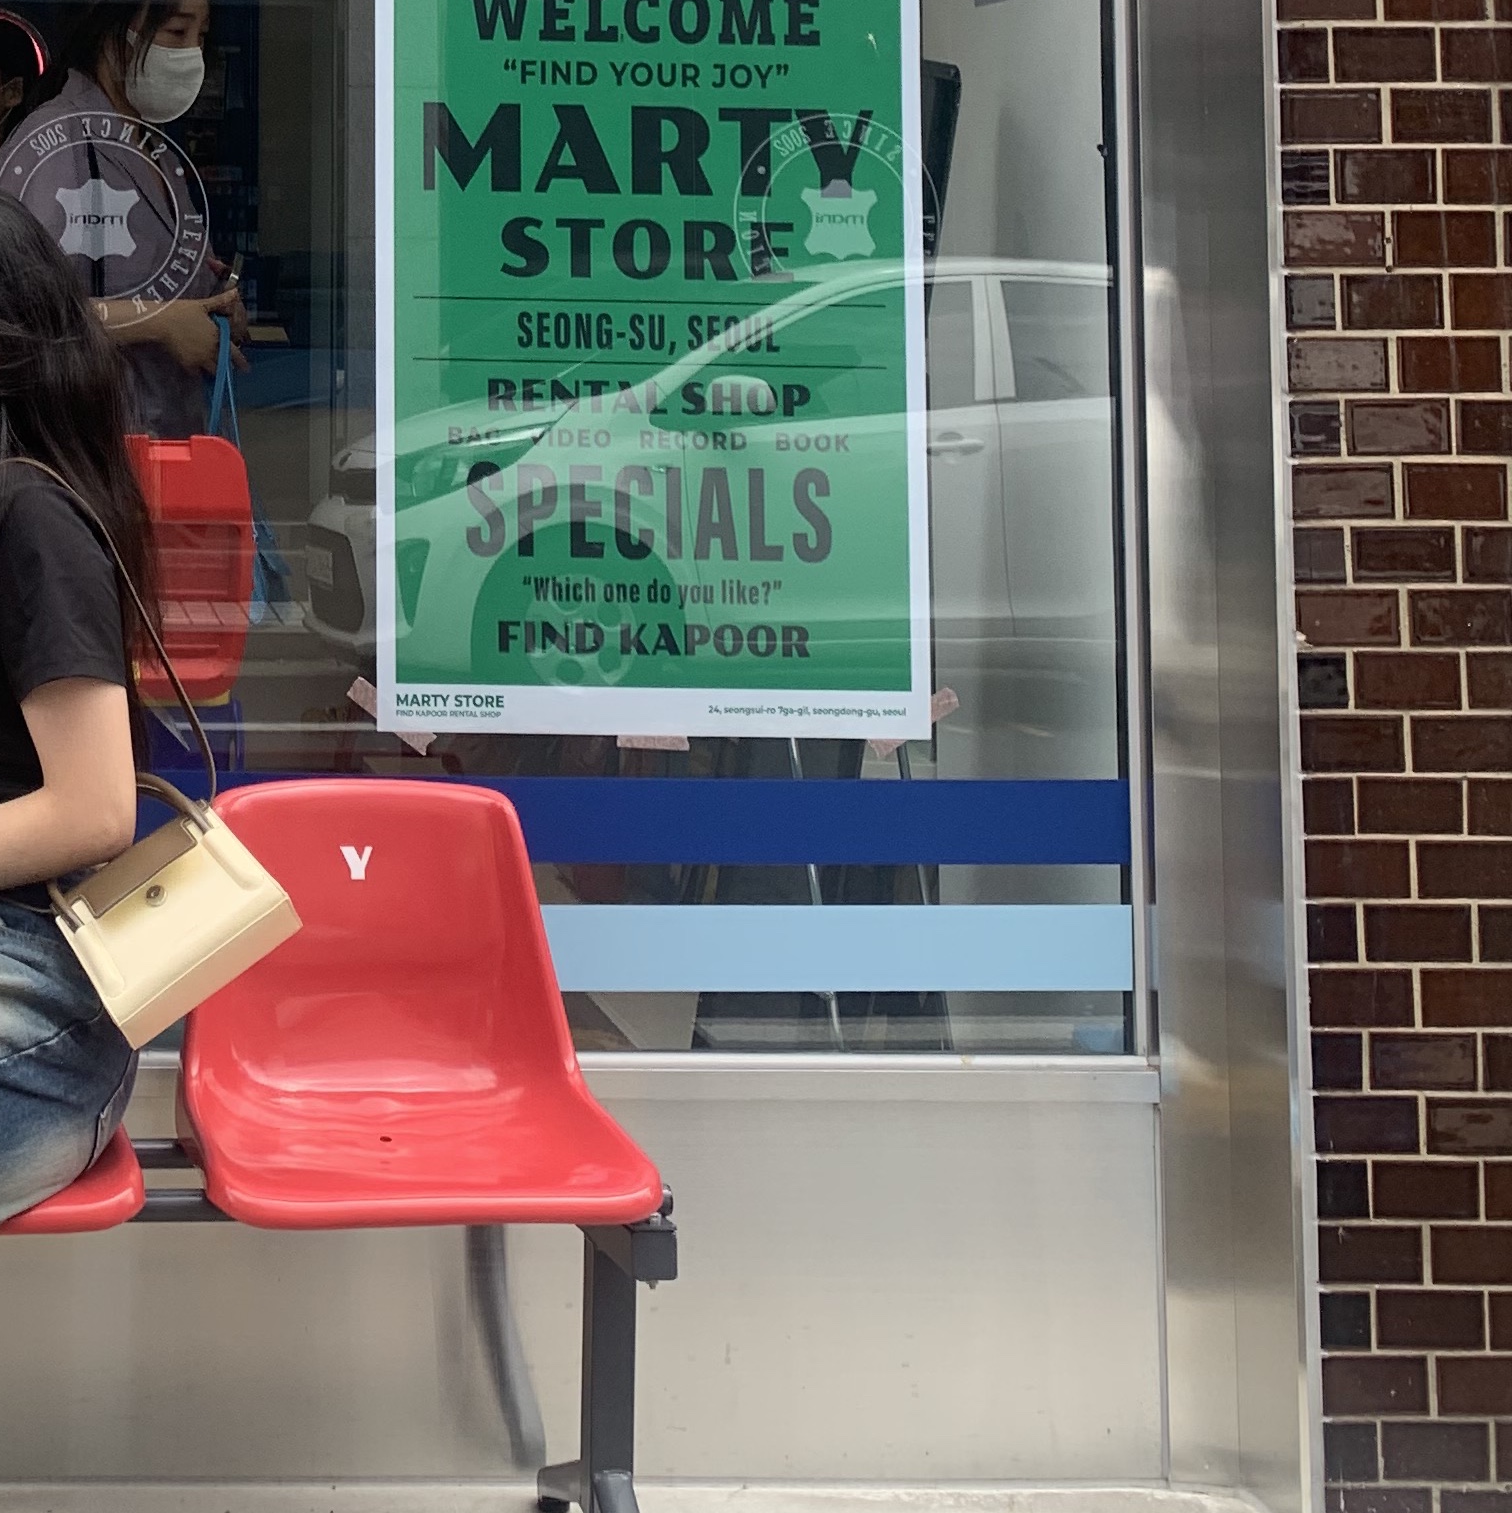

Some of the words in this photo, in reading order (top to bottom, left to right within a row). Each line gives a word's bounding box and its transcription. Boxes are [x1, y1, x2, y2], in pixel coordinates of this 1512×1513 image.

[608, 61, 701, 88] YOUR
[422, 101, 874, 199] MARTY
[499, 216, 794, 282] STORE
[516, 311, 677, 356] SEONG-SU,
[686, 314, 781, 354] SEOUL
[487, 377, 668, 415] RENTAL
[681, 381, 812, 417] SHOP
[530, 427, 612, 449] VIDEO
[639, 429, 748, 451] RECORD
[774, 432, 850, 453] BOOK
[465, 460, 833, 564] SPECIALS
[603, 582, 641, 604] one
[646, 578, 672, 605] do
[677, 583, 715, 610] you
[498, 620, 605, 655] FIND
[619, 623, 811, 658] KAPOOR
[395, 693, 450, 707] MARTY
[454, 694, 505, 708] STORE
[395, 709, 414, 717] FIND
[415, 710, 448, 718] KAPOOR
[449, 710, 478, 718] RENTAL
[480, 710, 502, 718] SHOP
[882, 707, 907, 717] seoul
[339, 845, 374, 881] Y
